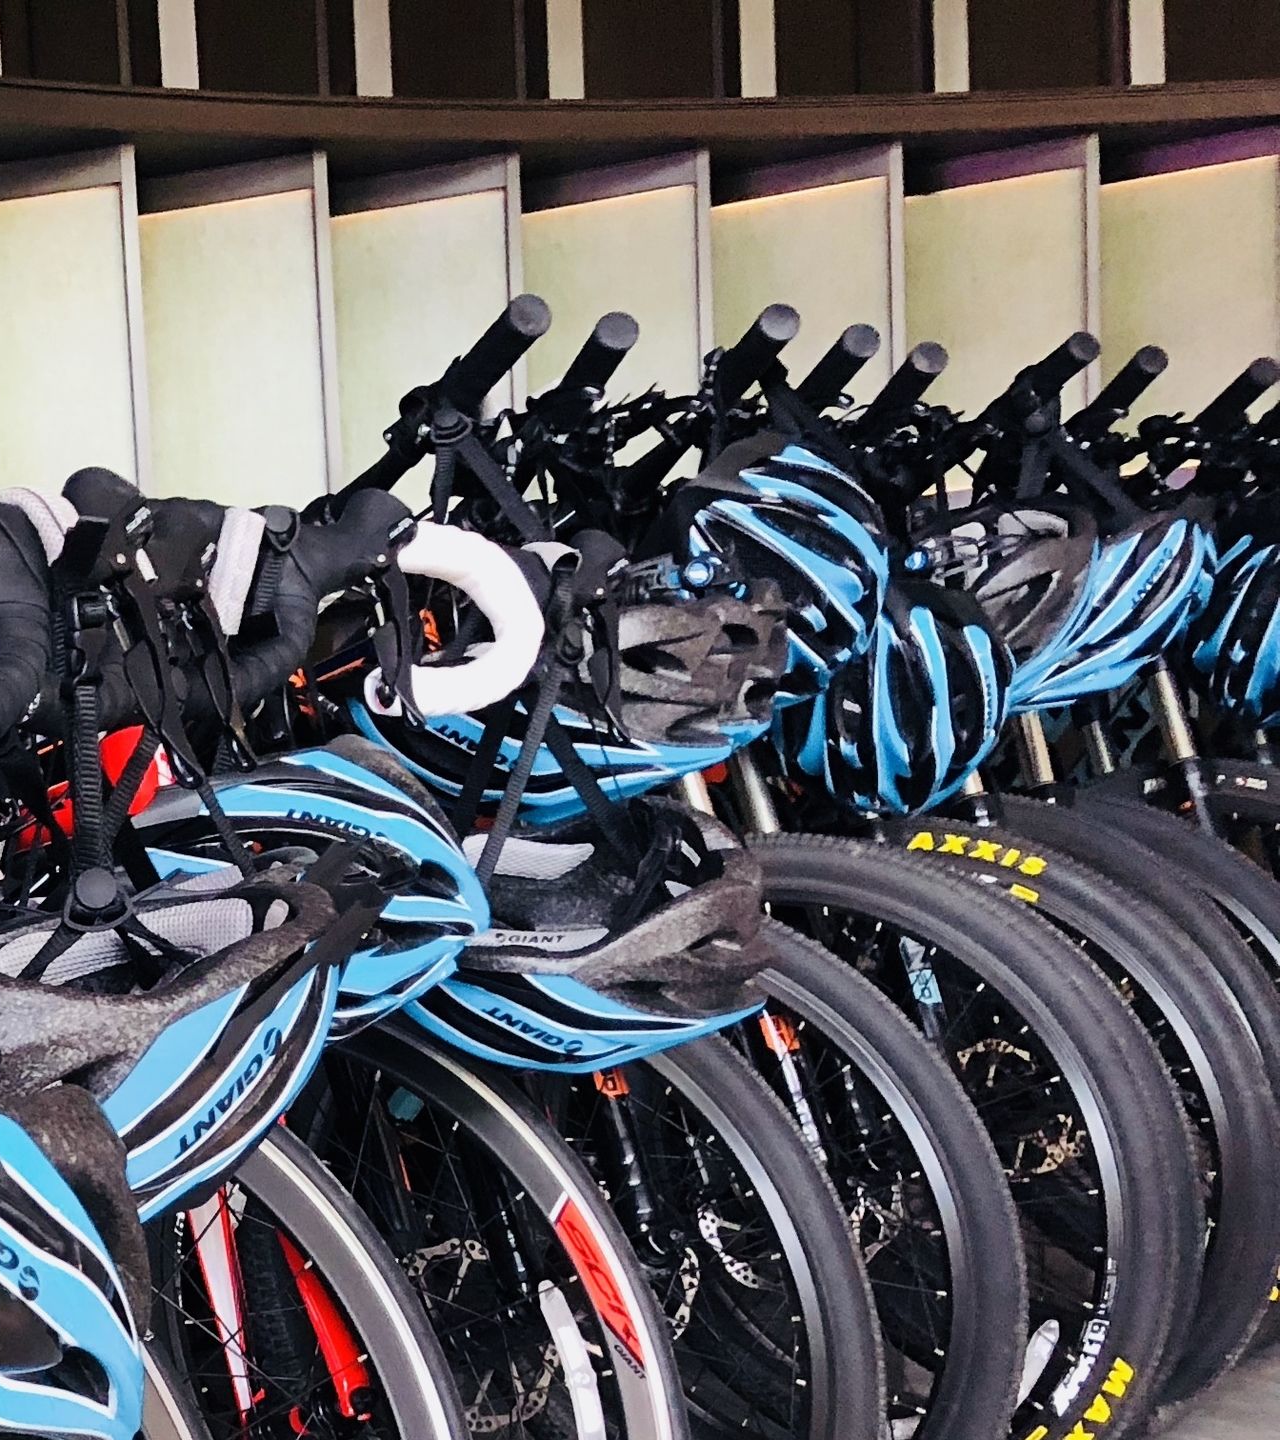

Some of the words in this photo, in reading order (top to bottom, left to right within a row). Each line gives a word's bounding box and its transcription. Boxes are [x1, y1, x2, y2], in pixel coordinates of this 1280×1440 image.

[433, 721, 508, 763] GANT
[907, 832, 1047, 875] AXXIS
[509, 934, 567, 944] GIANT
[481, 1004, 568, 1049] GIANT
[173, 1044, 274, 1161] GIANT
[614, 1343, 647, 1380] GIANT
